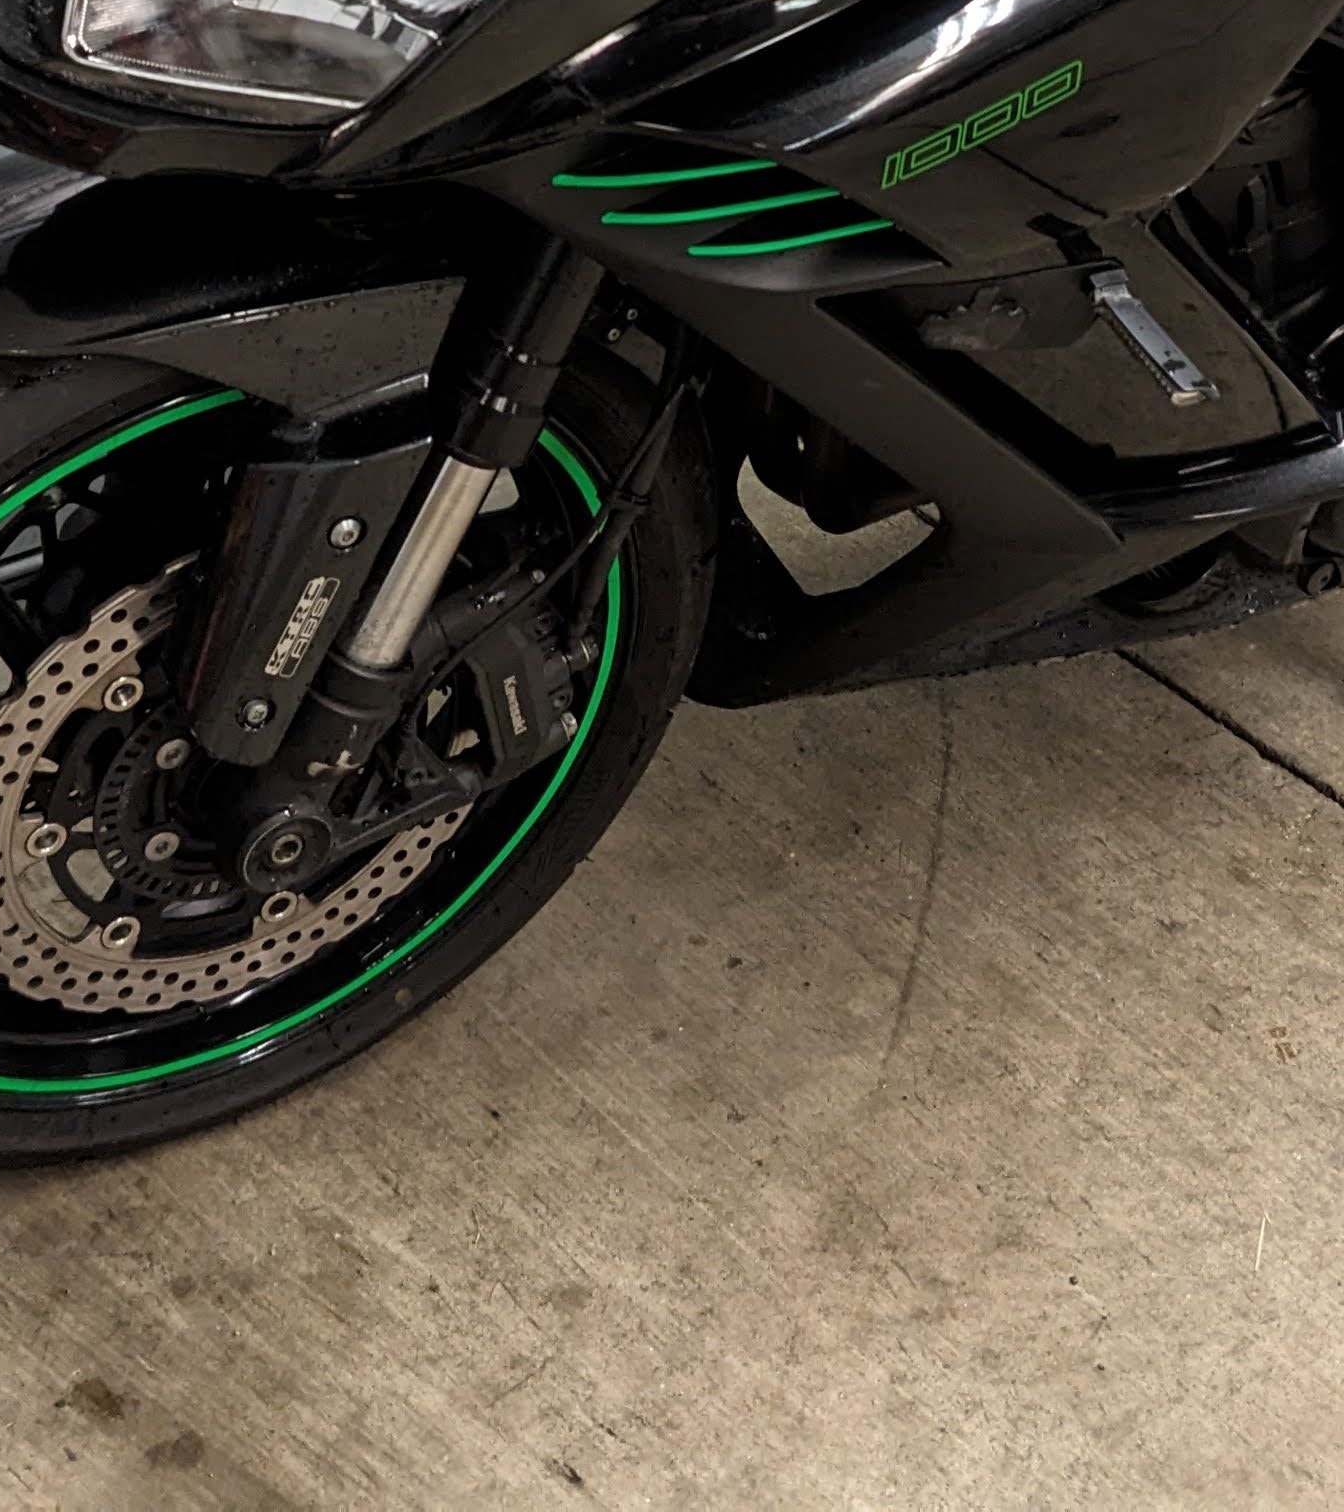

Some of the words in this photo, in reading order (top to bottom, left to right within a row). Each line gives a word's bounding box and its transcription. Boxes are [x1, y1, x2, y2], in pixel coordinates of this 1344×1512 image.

[881, 59, 1083, 189] 1000
[266, 577, 324, 675] KTRC
[290, 597, 328, 659] ABS
